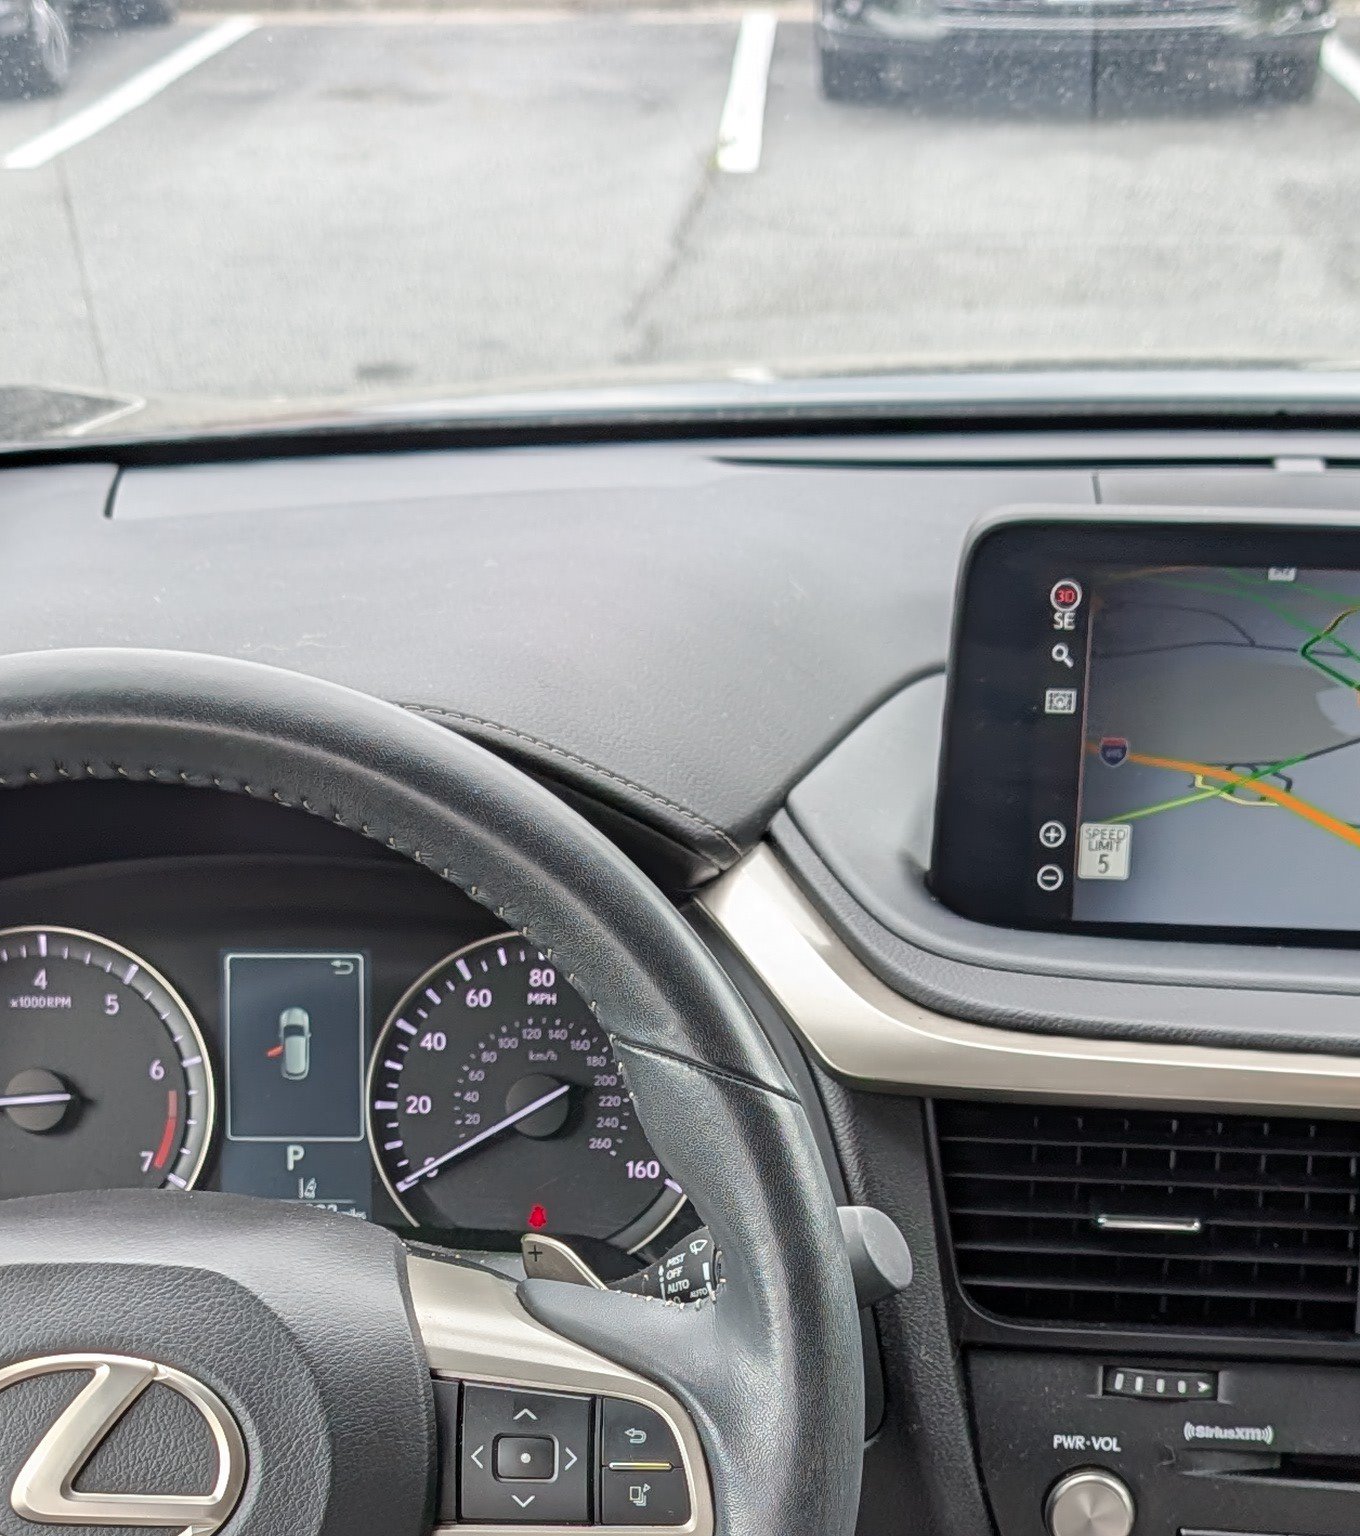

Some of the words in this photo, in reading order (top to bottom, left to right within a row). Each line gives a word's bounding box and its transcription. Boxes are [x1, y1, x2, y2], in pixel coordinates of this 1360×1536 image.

[1057, 588, 1076, 602] 3D
[1053, 612, 1076, 630] SE
[1085, 828, 1126, 840] SPEED
[1088, 840, 1121, 851] LIMIT
[1098, 854, 1110, 874] 5
[33, 969, 48, 990] 4
[528, 968, 556, 988] 80
[104, 994, 120, 1015] 5
[465, 989, 492, 1008] 60
[526, 992, 558, 1006] MPH
[522, 1028, 542, 1040] 120
[548, 1029, 568, 1041] 140
[420, 1032, 447, 1051] 40
[498, 1037, 519, 1049] 100
[570, 1039, 591, 1051] 160
[481, 1051, 498, 1063] 80
[528, 1050, 558, 1062] km/h
[586, 1055, 607, 1067] 180
[149, 1059, 166, 1081] 6
[468, 1070, 485, 1082] 60
[594, 1075, 618, 1086] 200
[463, 1091, 480, 1102] 40
[598, 1096, 622, 1108] 220
[406, 1095, 432, 1114] 20
[464, 1113, 481, 1125] 20
[596, 1117, 620, 1129] 240
[589, 1138, 612, 1150] 260
[139, 1151, 155, 1173] 7
[286, 1145, 305, 1171] P
[625, 1161, 660, 1179] 160
[666, 1253, 686, 1268] MIST
[666, 1266, 683, 1280] OFF
[667, 1279, 690, 1294] AUTO
